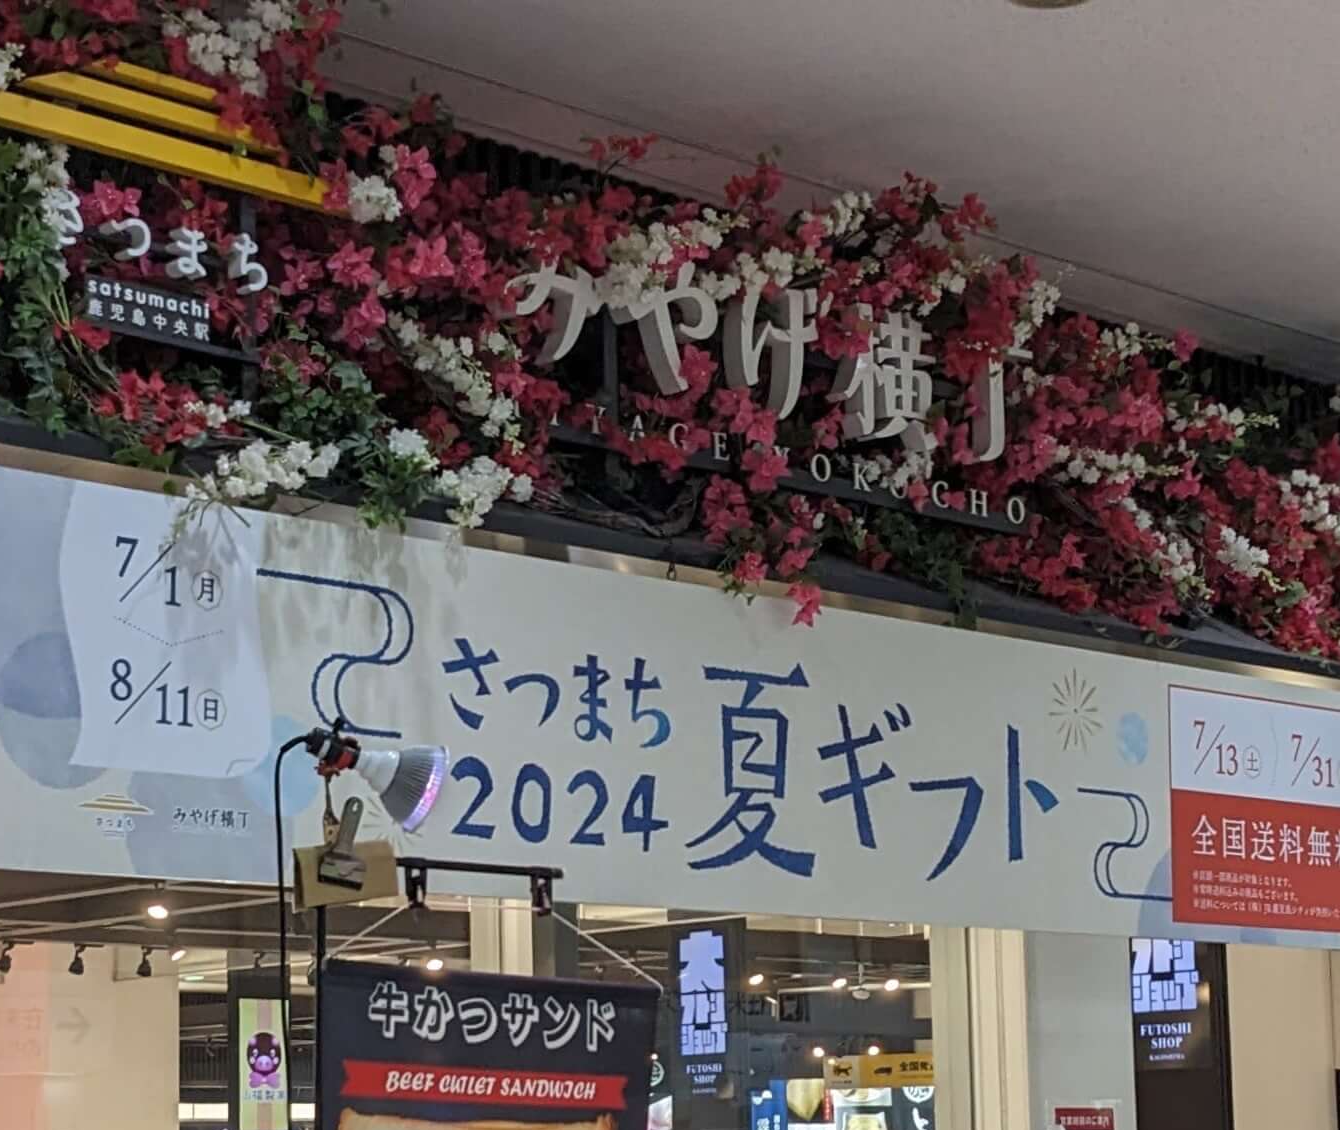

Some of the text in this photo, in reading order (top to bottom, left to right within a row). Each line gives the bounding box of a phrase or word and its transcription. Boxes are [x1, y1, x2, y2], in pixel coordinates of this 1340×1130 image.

[88, 279, 210, 319] satsumachi
[88, 299, 210, 341] 鹿児島中央駅
[549, 403, 730, 461] YAGE
[442, 637, 671, 748] さつまち
[686, 663, 1058, 881] 夏ギフト
[173, 807, 250, 828] みやげ横丁
[450, 755, 669, 852] 2024
[368, 980, 617, 1052] 牛かつサンド
[1140, 1022, 1192, 1036] FUTOSHI
[1151, 1036, 1183, 1049] SHOP
[385, 1071, 434, 1092] BEEF
[499, 1078, 596, 1100] SANDWICH
[900, 1061, 934, 1073] 全国発
